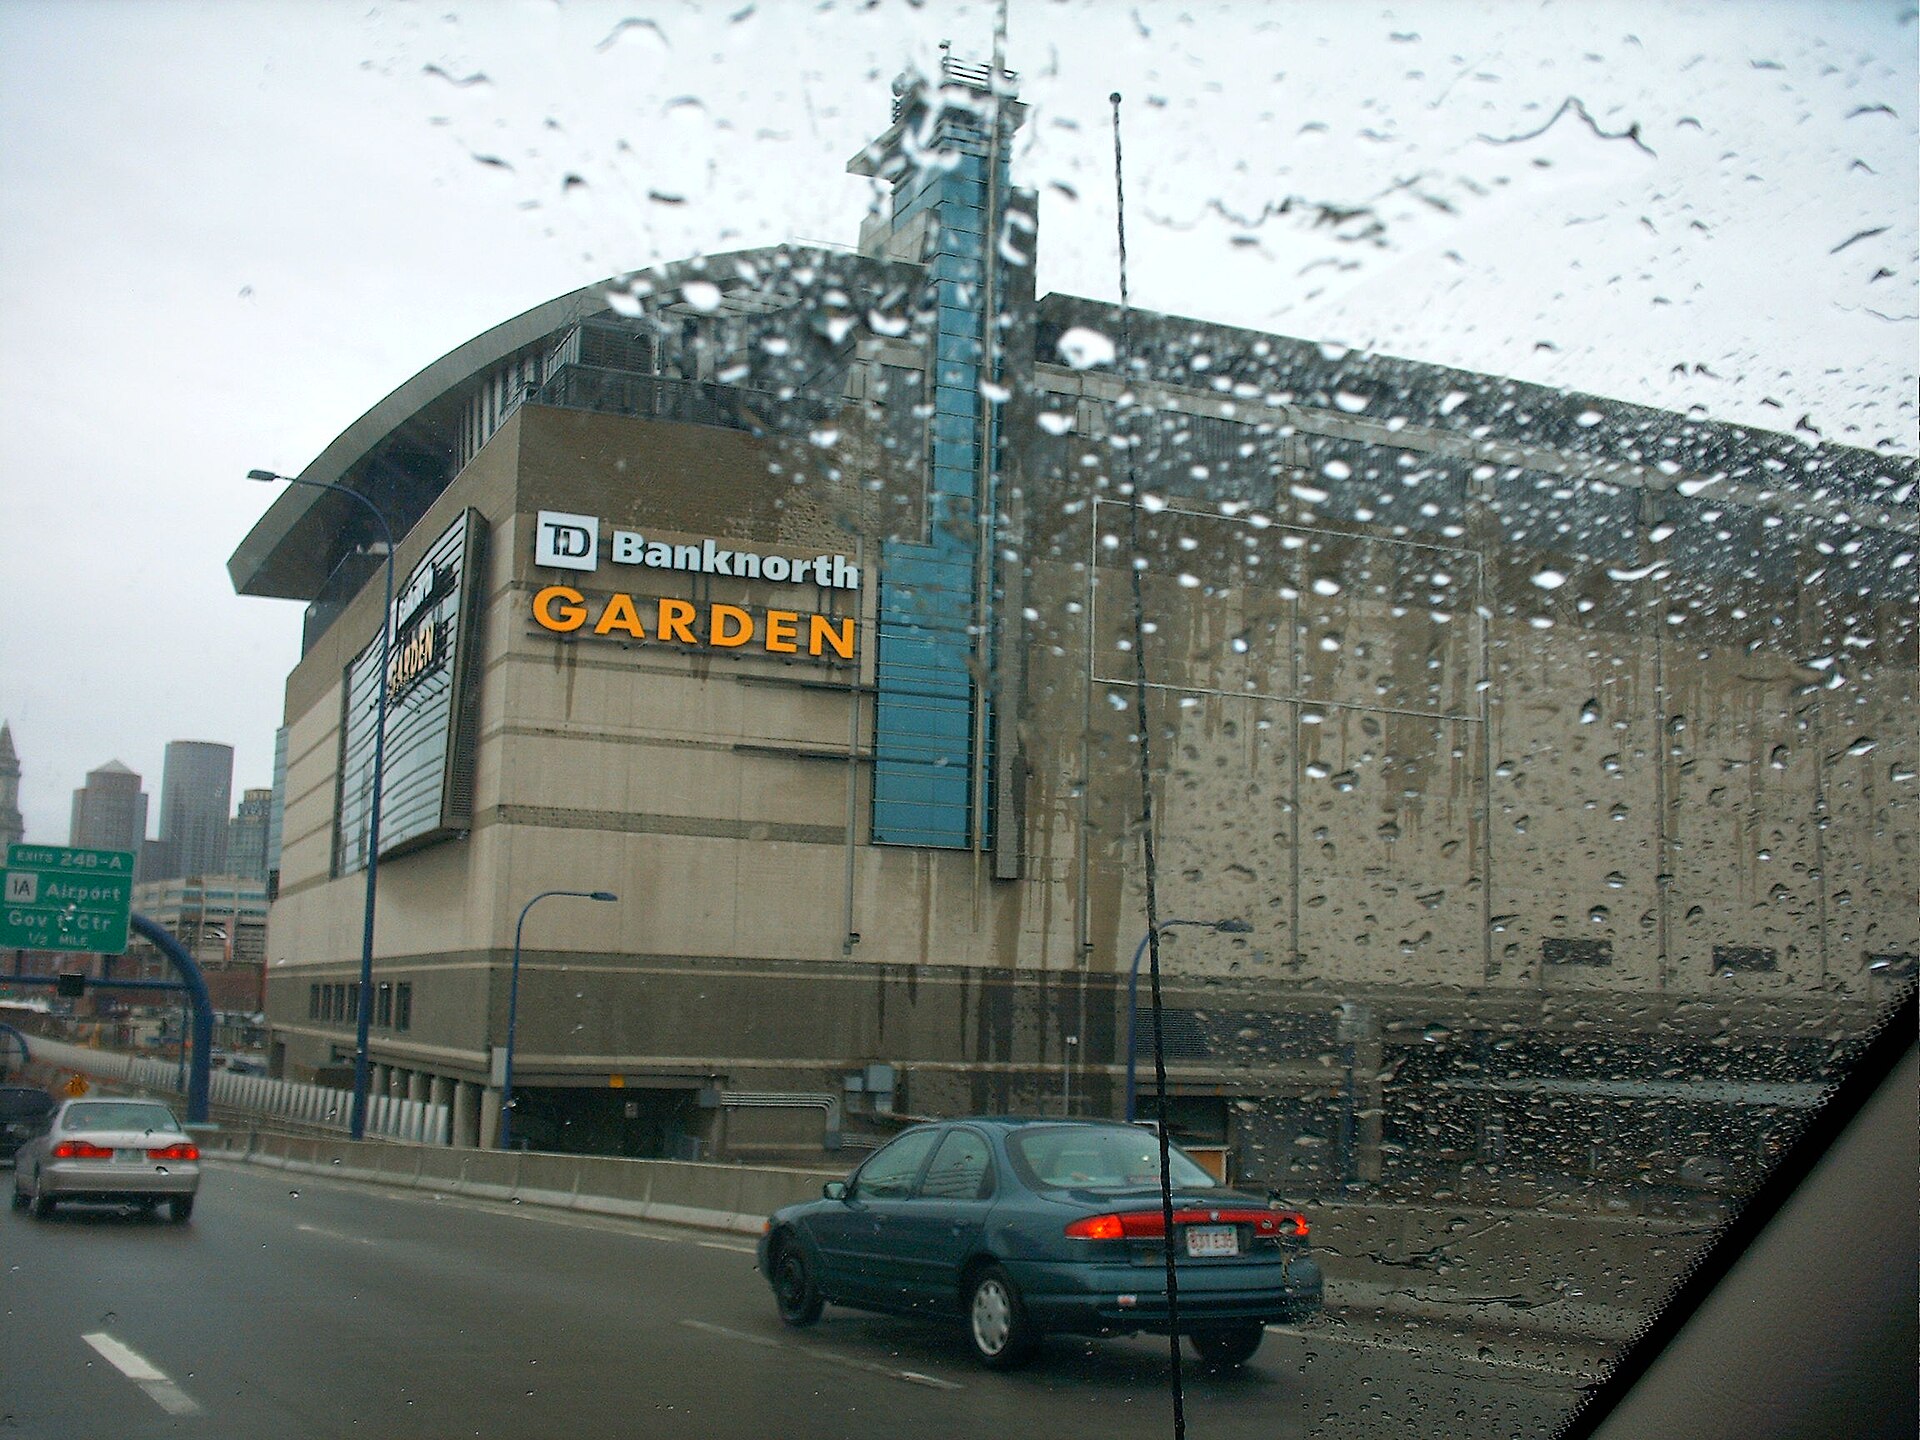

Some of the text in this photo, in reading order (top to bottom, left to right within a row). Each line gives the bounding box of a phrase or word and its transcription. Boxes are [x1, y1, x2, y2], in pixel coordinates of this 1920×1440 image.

[544, 522, 859, 590] TD Banknorth
[532, 585, 855, 659] GARDEN
[16, 850, 53, 863] EXITS
[45, 883, 121, 903] Airport
[77, 913, 112, 931] Ctr
[59, 934, 89, 947] MILE
